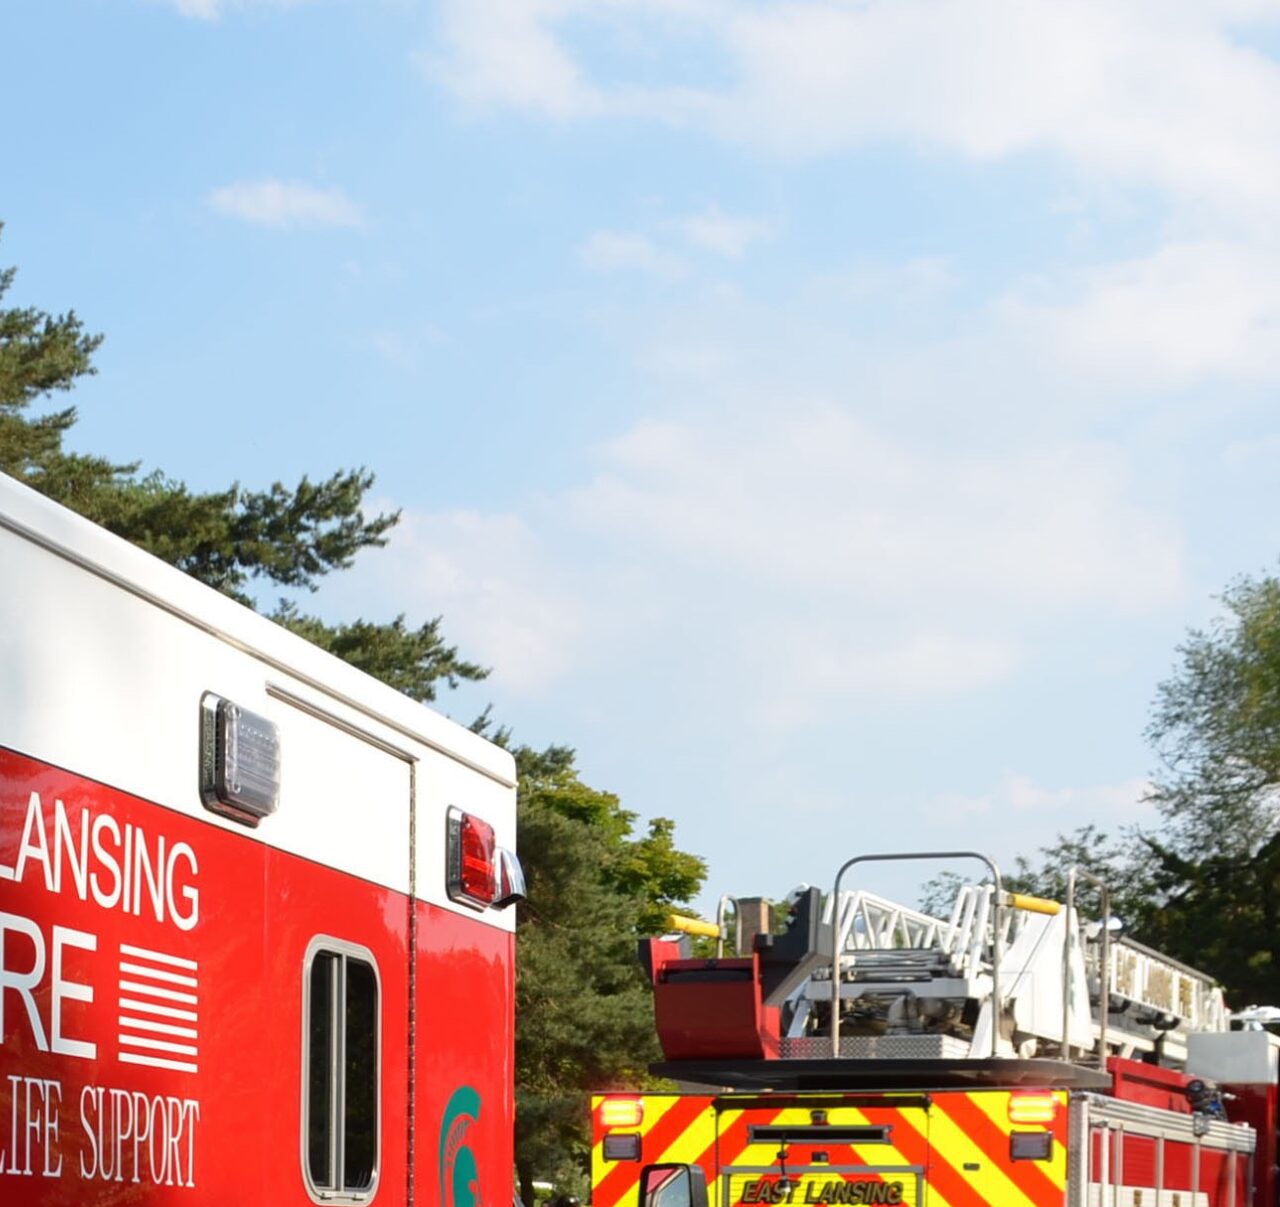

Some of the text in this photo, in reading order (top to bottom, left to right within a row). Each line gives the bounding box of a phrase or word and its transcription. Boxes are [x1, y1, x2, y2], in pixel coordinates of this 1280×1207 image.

[80, 1085, 200, 1188] SUPPORT
[742, 1180, 903, 1206] EAST LANSING
